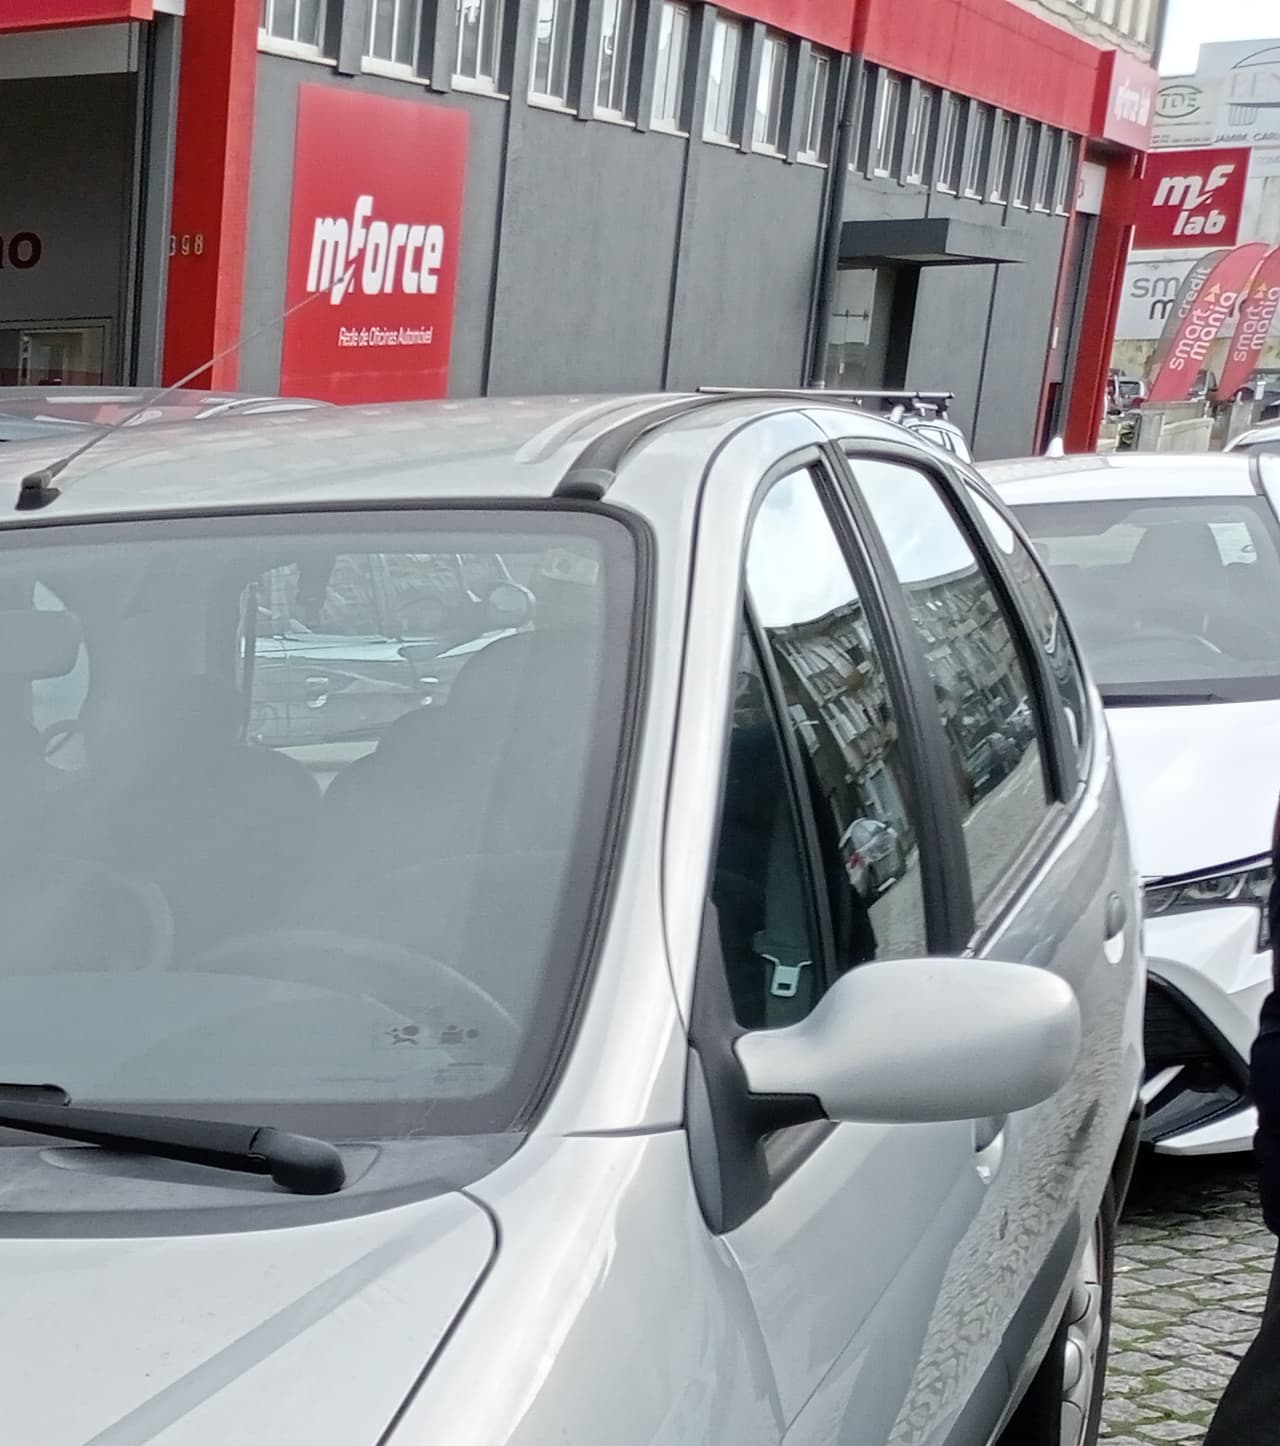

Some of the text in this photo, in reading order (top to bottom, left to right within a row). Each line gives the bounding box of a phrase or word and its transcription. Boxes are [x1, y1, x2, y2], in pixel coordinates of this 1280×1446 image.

[1172, 209, 1226, 236] lab
[1169, 307, 1208, 371] smart
[1190, 291, 1239, 361] mania
[1233, 305, 1261, 362] smart
